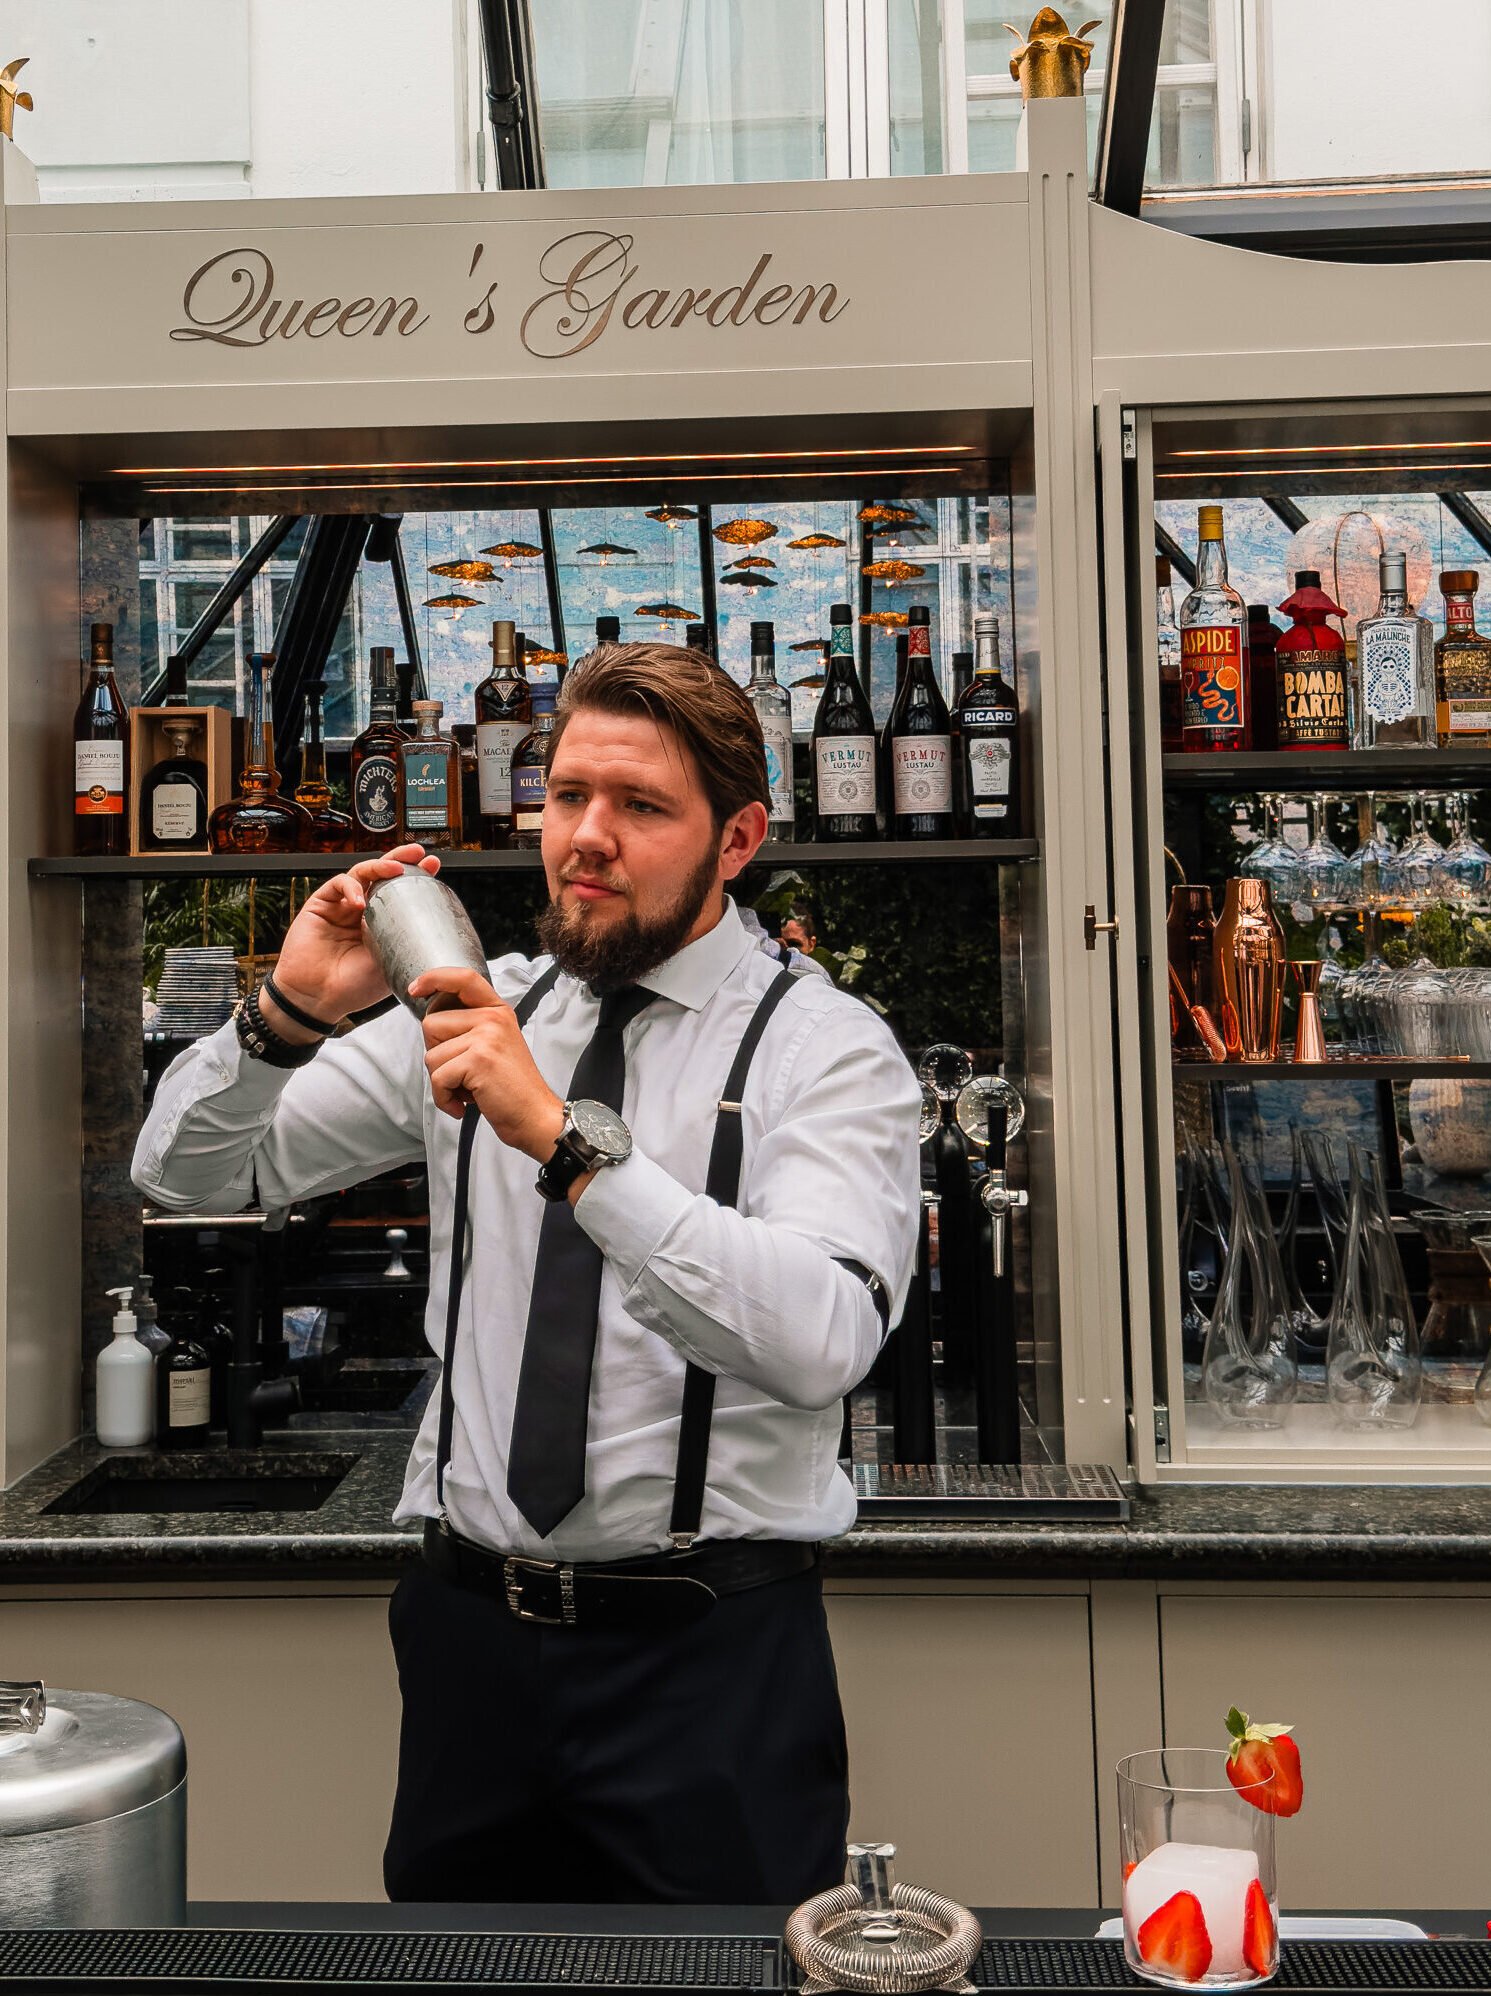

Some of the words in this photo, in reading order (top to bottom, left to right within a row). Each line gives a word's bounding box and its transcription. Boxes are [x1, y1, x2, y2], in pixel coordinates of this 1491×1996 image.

[169, 247, 430, 347] Queen
[520, 231, 850, 359] Garden
[1183, 630, 1233, 653] ASPIDE
[1366, 635, 1375, 645] LA
[1375, 632, 1411, 644] MALINCHE
[1284, 671, 1345, 696] BOMBA
[1286, 694, 1345, 719] CARTA!
[964, 711, 1013, 722] RICARD
[1289, 719, 1319, 728] Silvio
[822, 749, 871, 763] VERMUT
[896, 749, 946, 763] VERMUT
[407, 778, 446, 786] LOCHLEA
